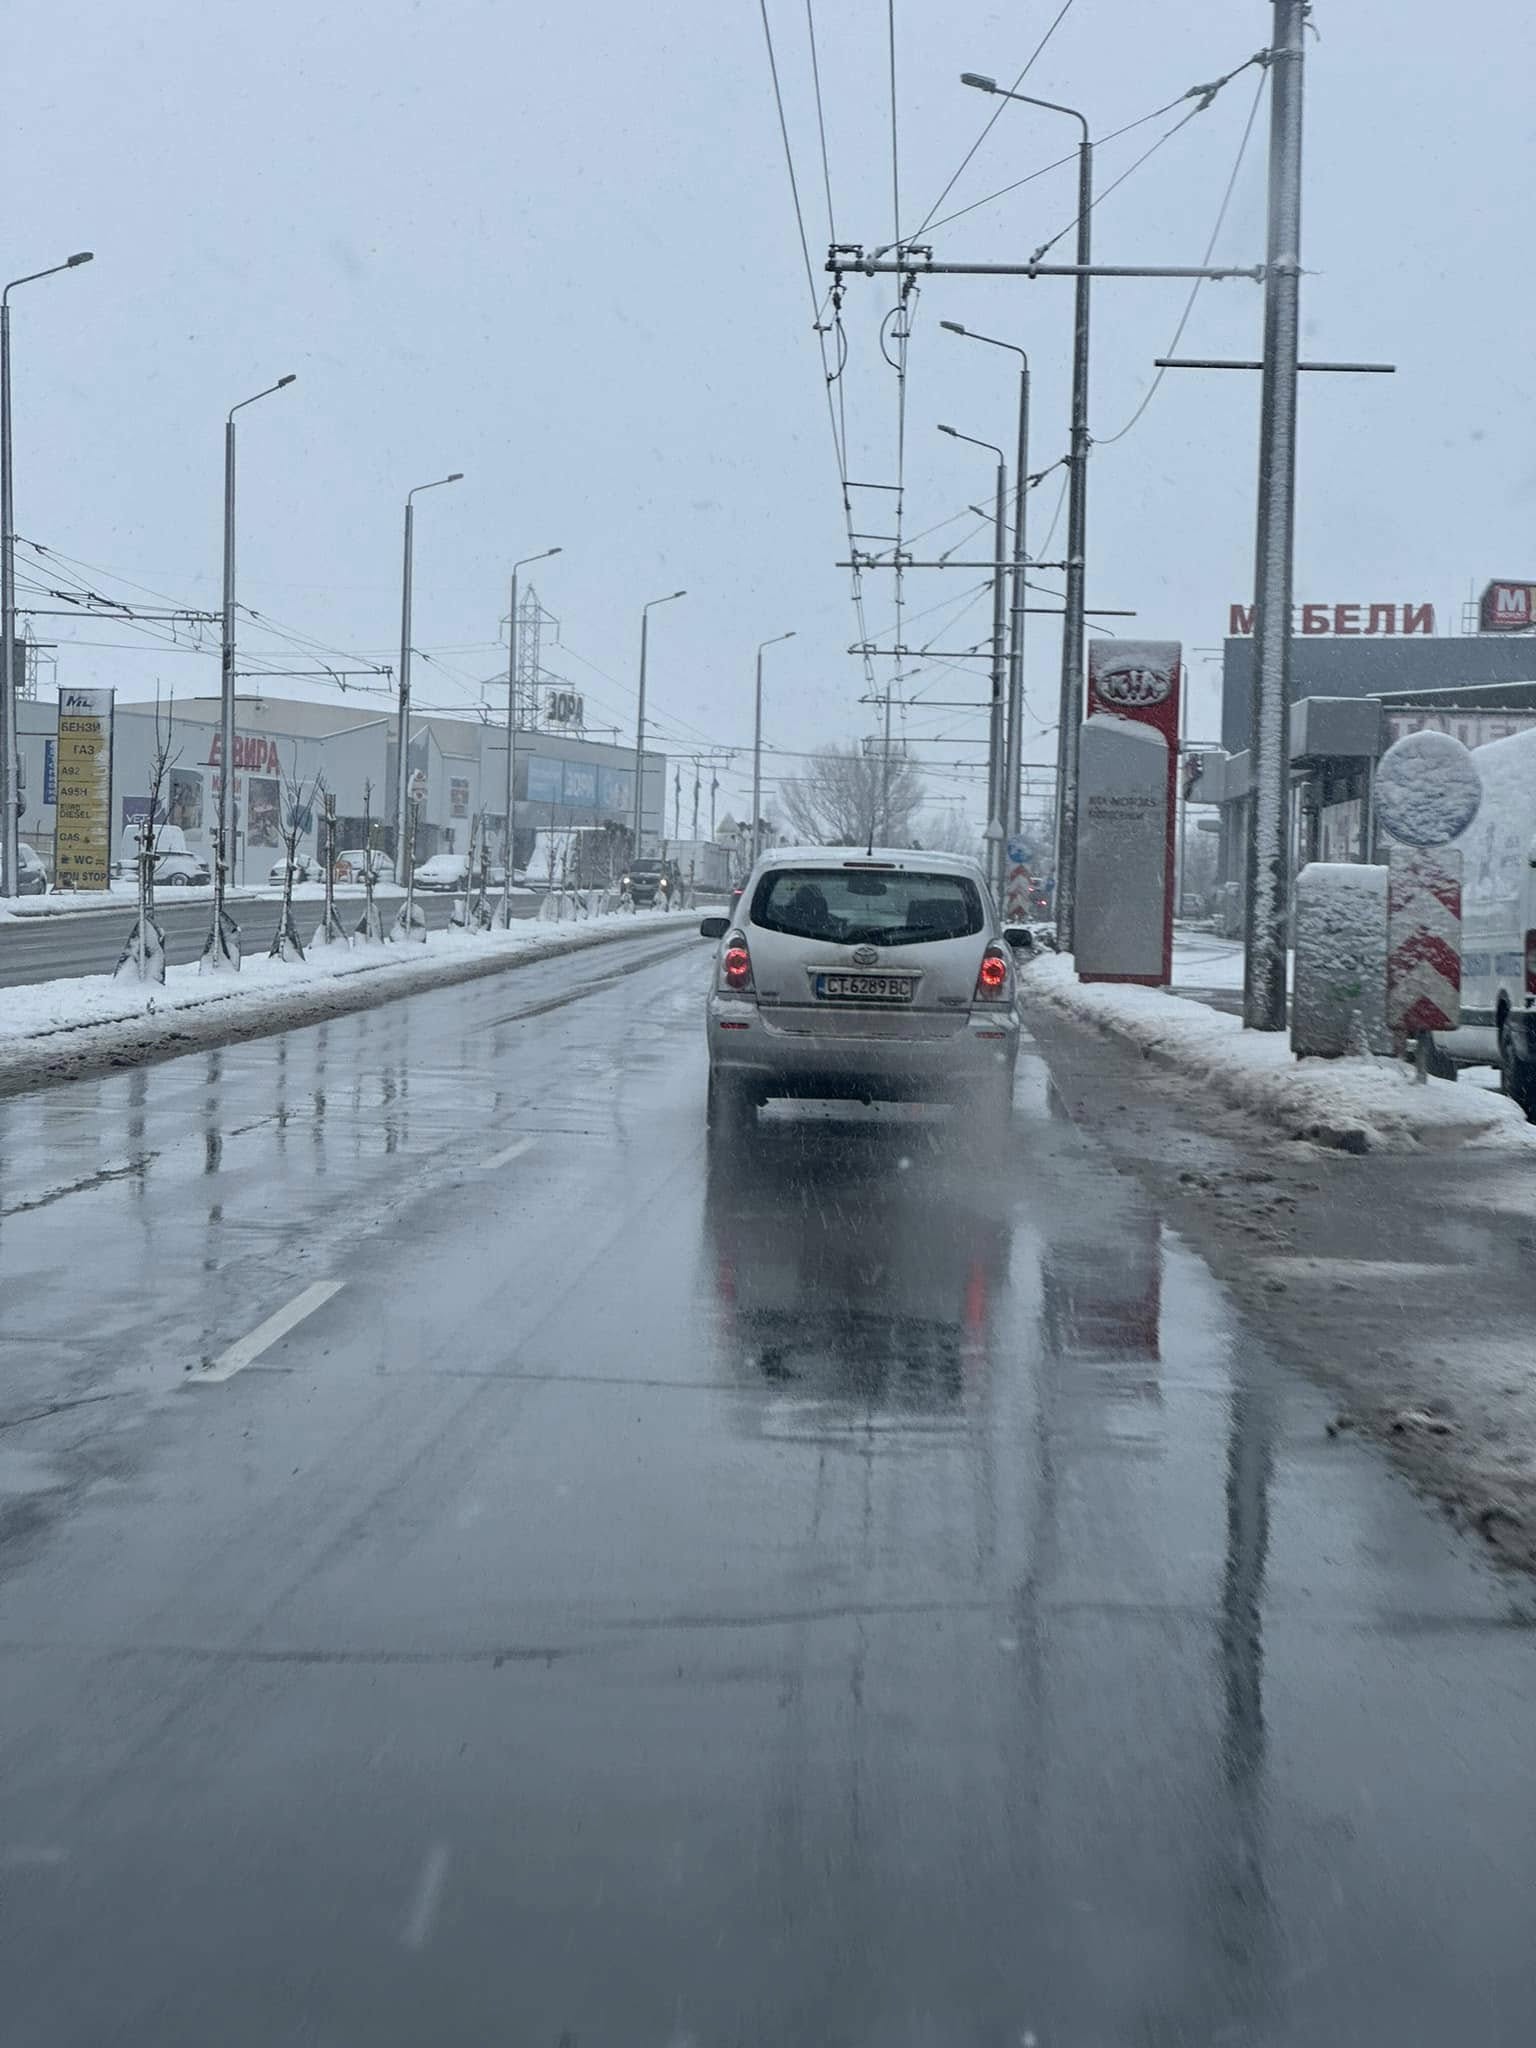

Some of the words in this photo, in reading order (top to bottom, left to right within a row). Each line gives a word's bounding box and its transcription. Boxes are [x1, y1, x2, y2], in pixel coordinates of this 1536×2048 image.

[1230, 603, 1434, 636] МБЕЛИ
[73, 745, 95, 755] ГАЗ
[208, 733, 280, 776] ЕВИРА
[62, 766, 80, 775] A92
[59, 832, 80, 841] GAS
[74, 855, 94, 865] WC
[82, 872, 107, 882] STOP
